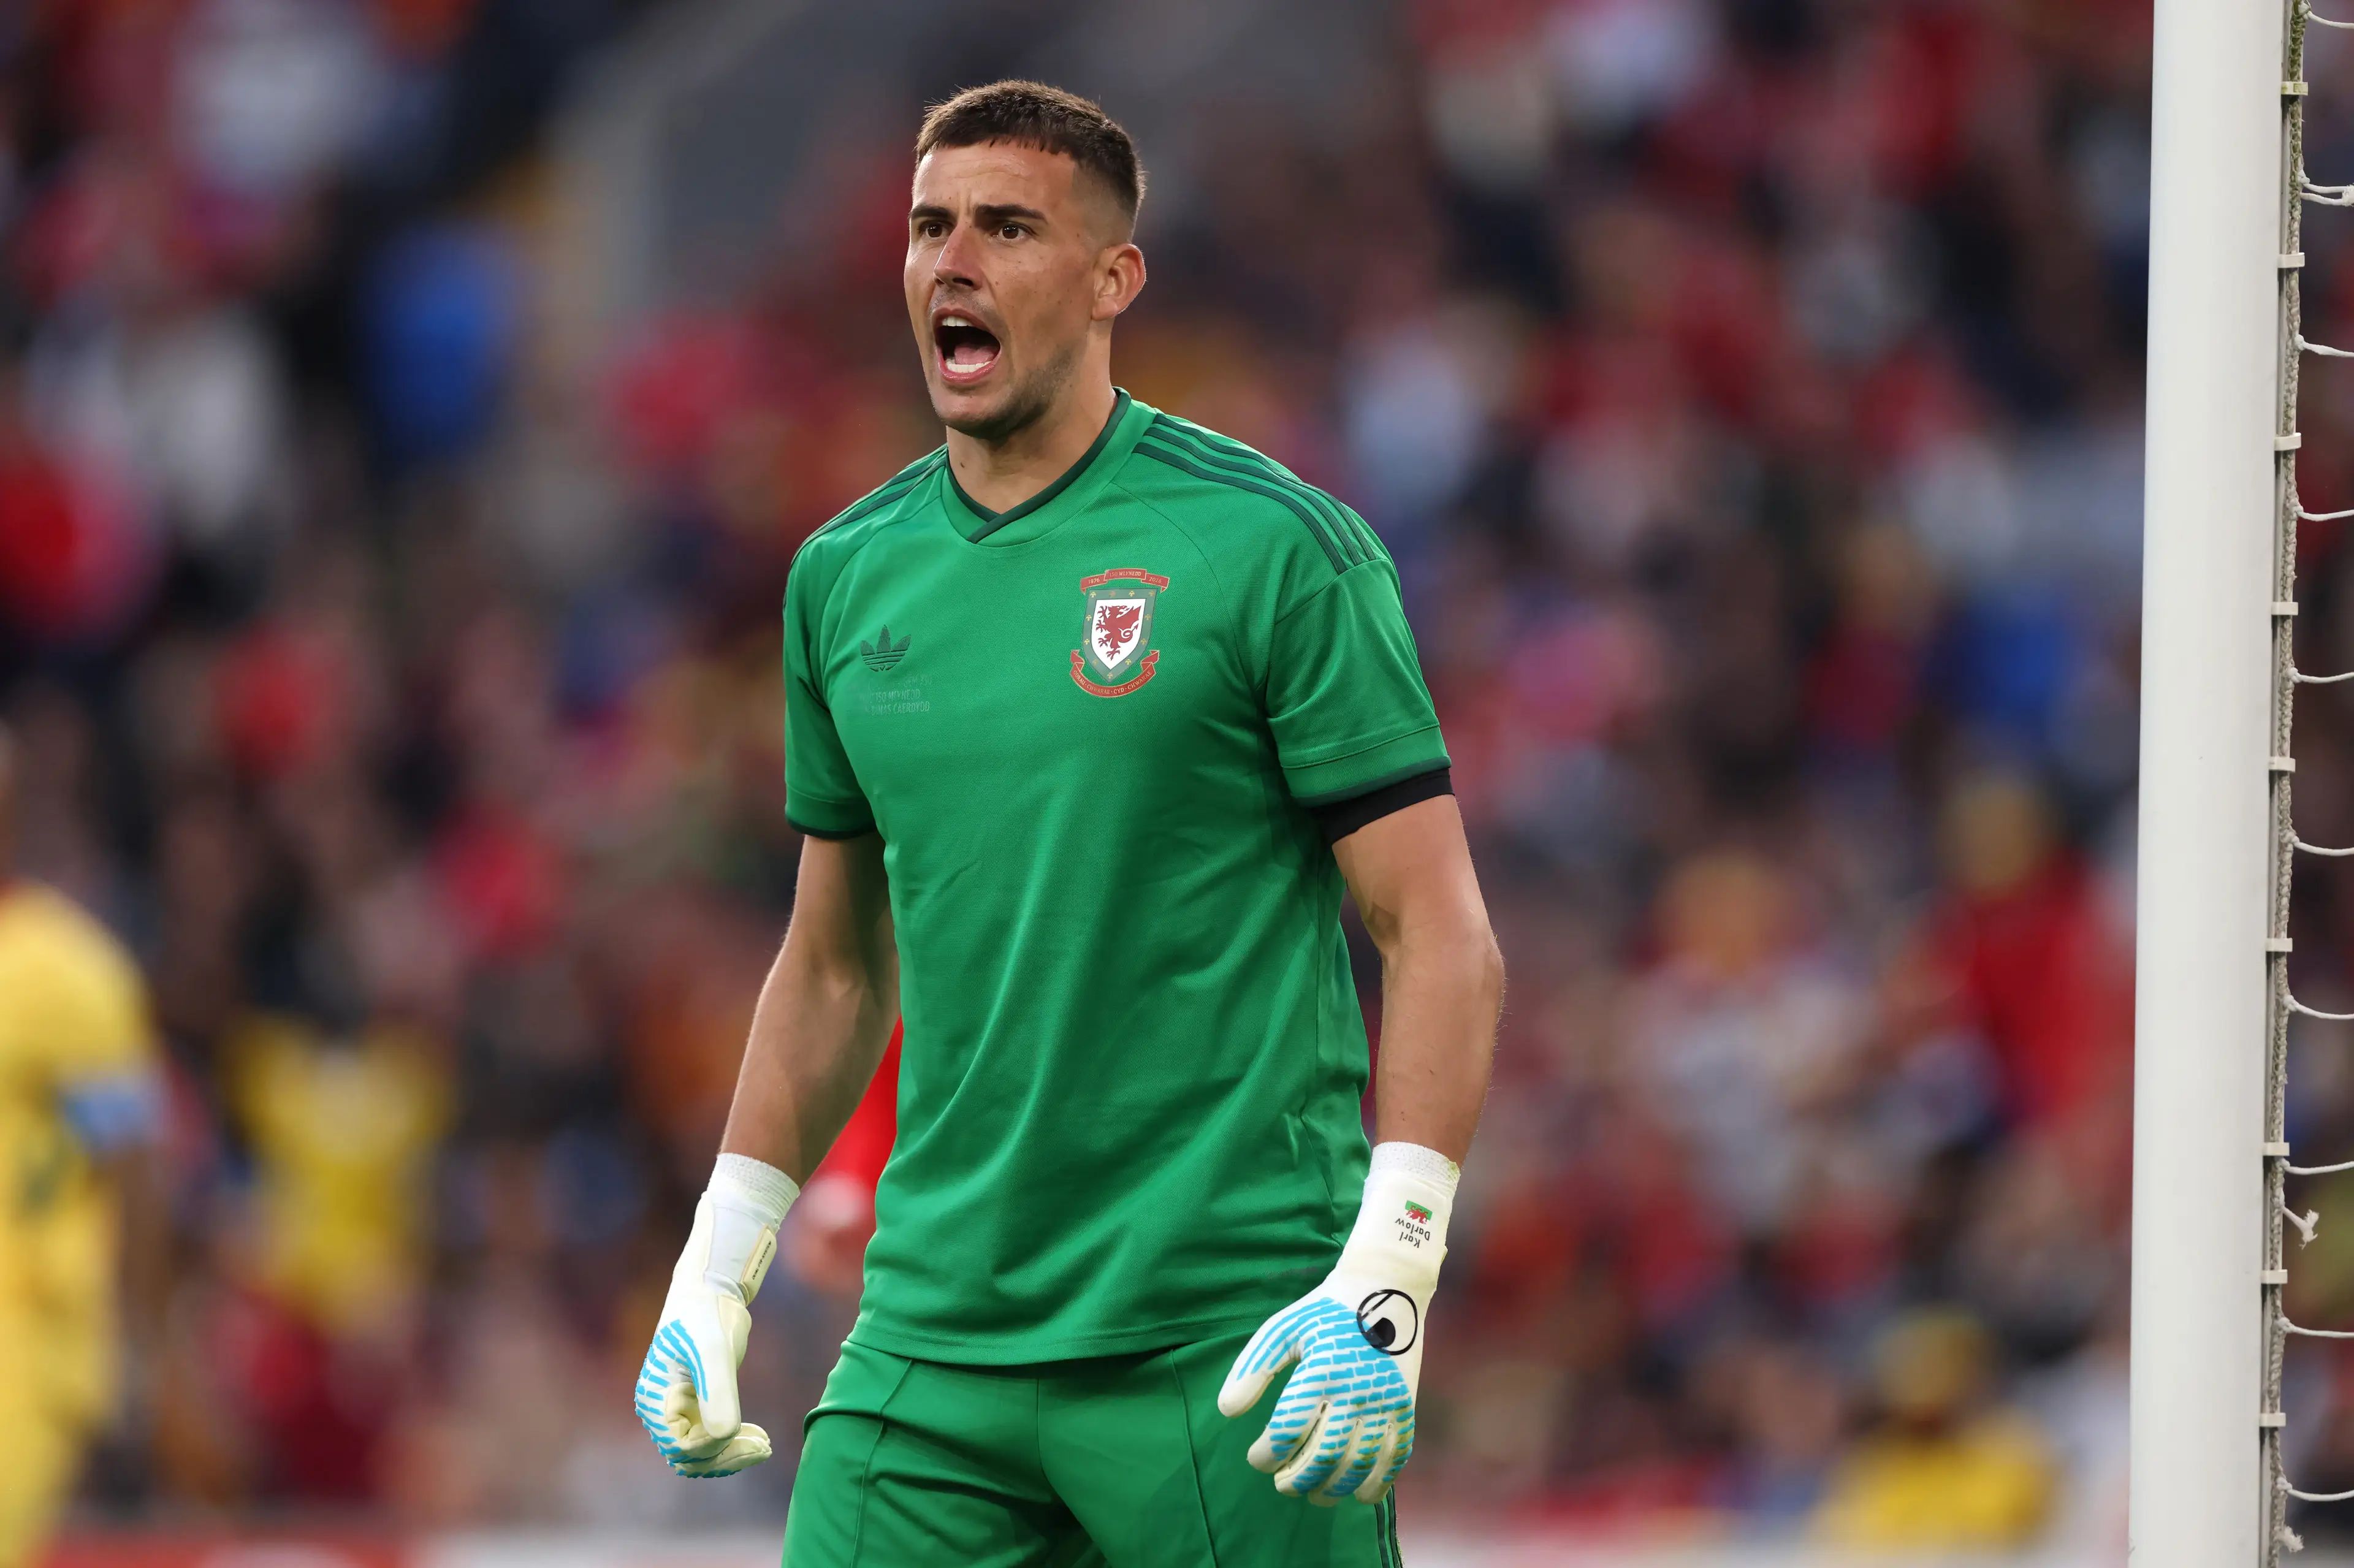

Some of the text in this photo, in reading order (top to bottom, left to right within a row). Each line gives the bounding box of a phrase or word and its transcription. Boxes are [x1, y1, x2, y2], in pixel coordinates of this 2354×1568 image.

[1073, 670, 1086, 685] GORAU
[1086, 684, 1110, 695] CHWARAE
[1127, 671, 1152, 690] CHWARAE
[1395, 1218, 1430, 1241] Darlow
[1399, 1231, 1420, 1248] Karl
